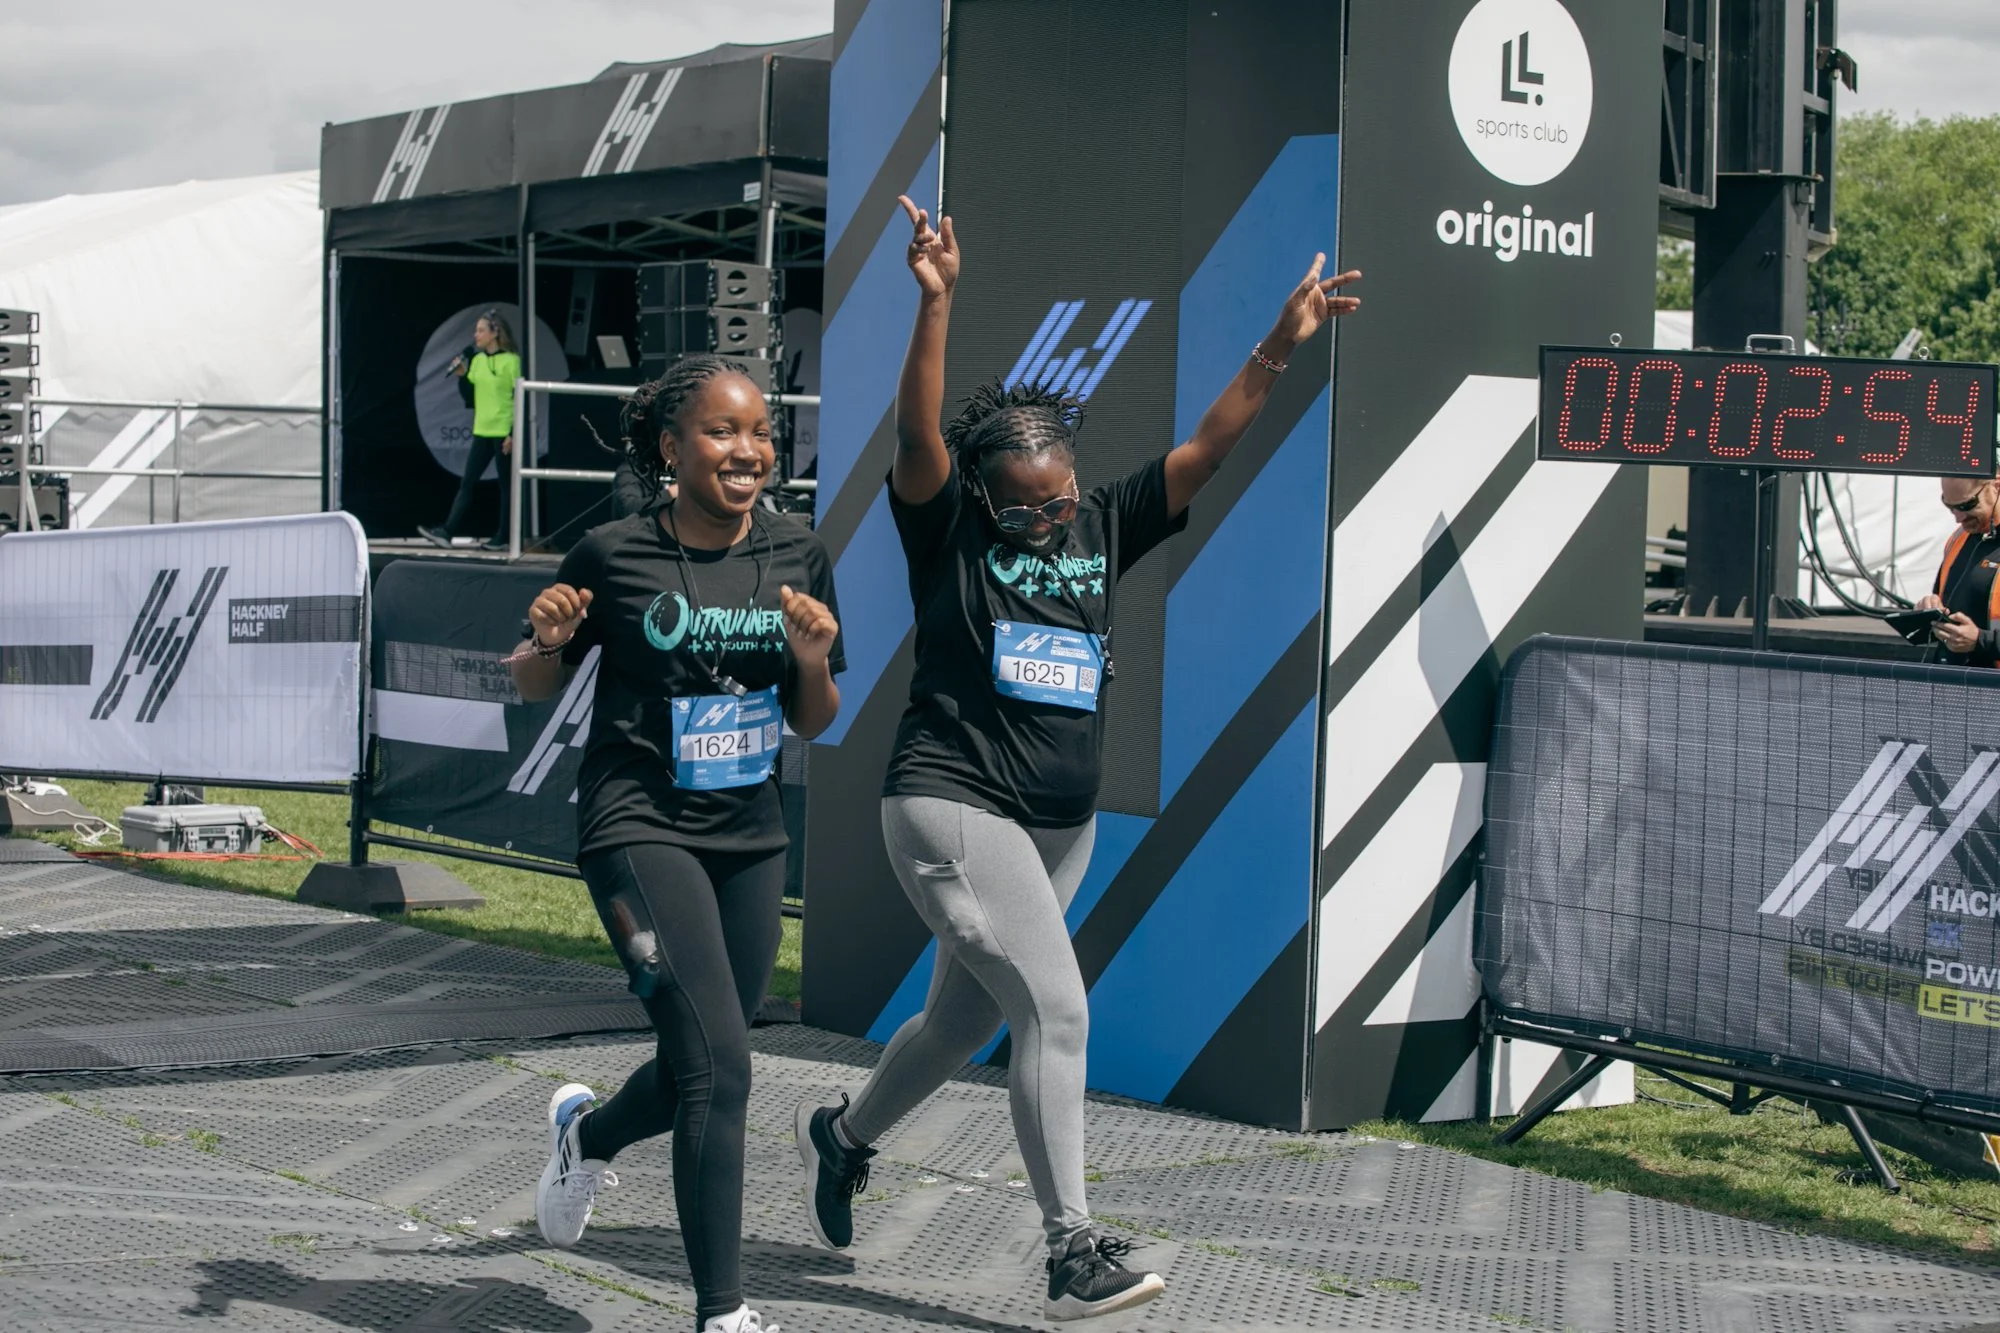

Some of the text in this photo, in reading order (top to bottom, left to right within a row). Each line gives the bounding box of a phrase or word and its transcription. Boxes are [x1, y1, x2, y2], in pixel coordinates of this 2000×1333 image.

[1476, 118, 1568, 144] sports club
[1436, 200, 1594, 262] original
[1558, 357, 1980, 466] 00:02:54
[231, 604, 289, 620] HACKNEY
[644, 591, 788, 651] OUTRUNNER
[231, 622, 265, 637] HALF
[720, 641, 759, 651] YOUTH
[1013, 660, 1065, 686] 1625
[694, 732, 751, 758] 1624
[1926, 958, 2000, 990] POW
[1923, 990, 2000, 1022] LET'S
